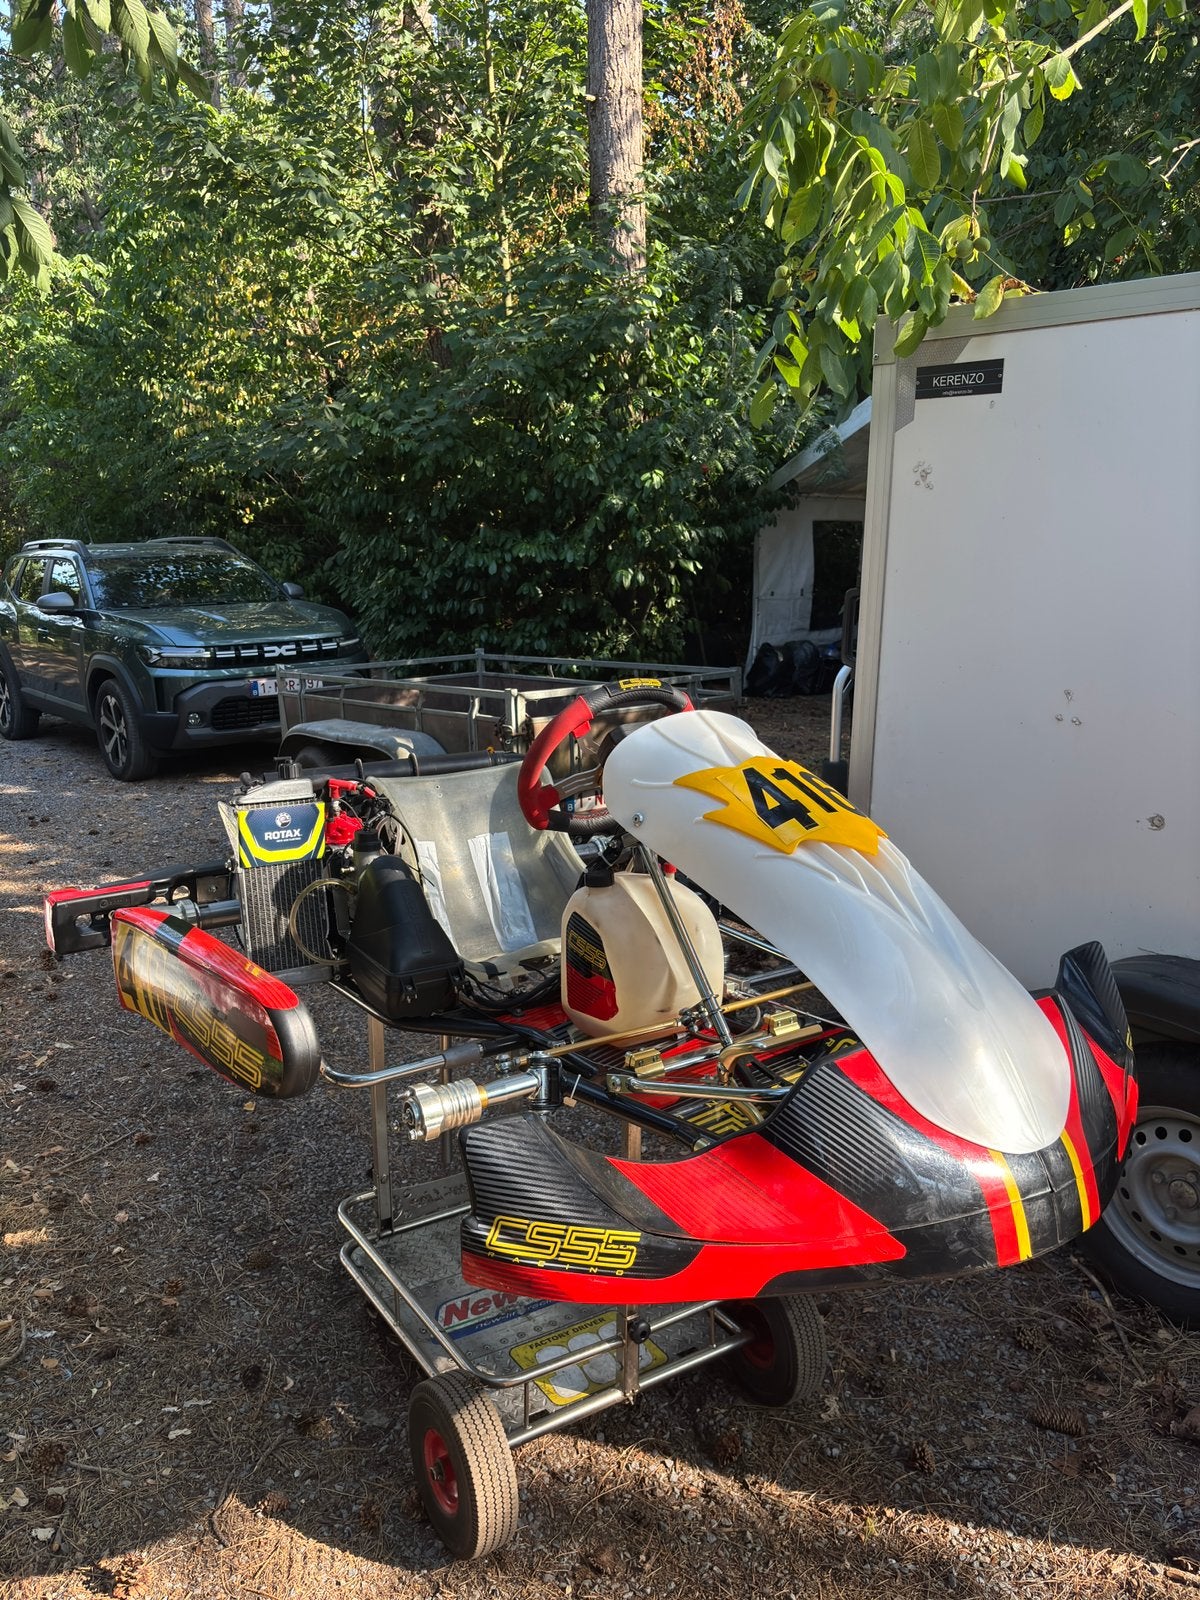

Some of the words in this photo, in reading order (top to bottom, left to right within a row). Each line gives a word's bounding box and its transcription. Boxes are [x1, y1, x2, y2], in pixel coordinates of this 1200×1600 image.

[932, 372, 985, 387] KERENZO
[567, 803, 573, 811] B
[742, 766, 868, 831] 416
[264, 828, 301, 841] ROTAX
[487, 1251, 624, 1276] RACING
[529, 1330, 570, 1350] FACTORY
[573, 1317, 606, 1333] DRIVER
